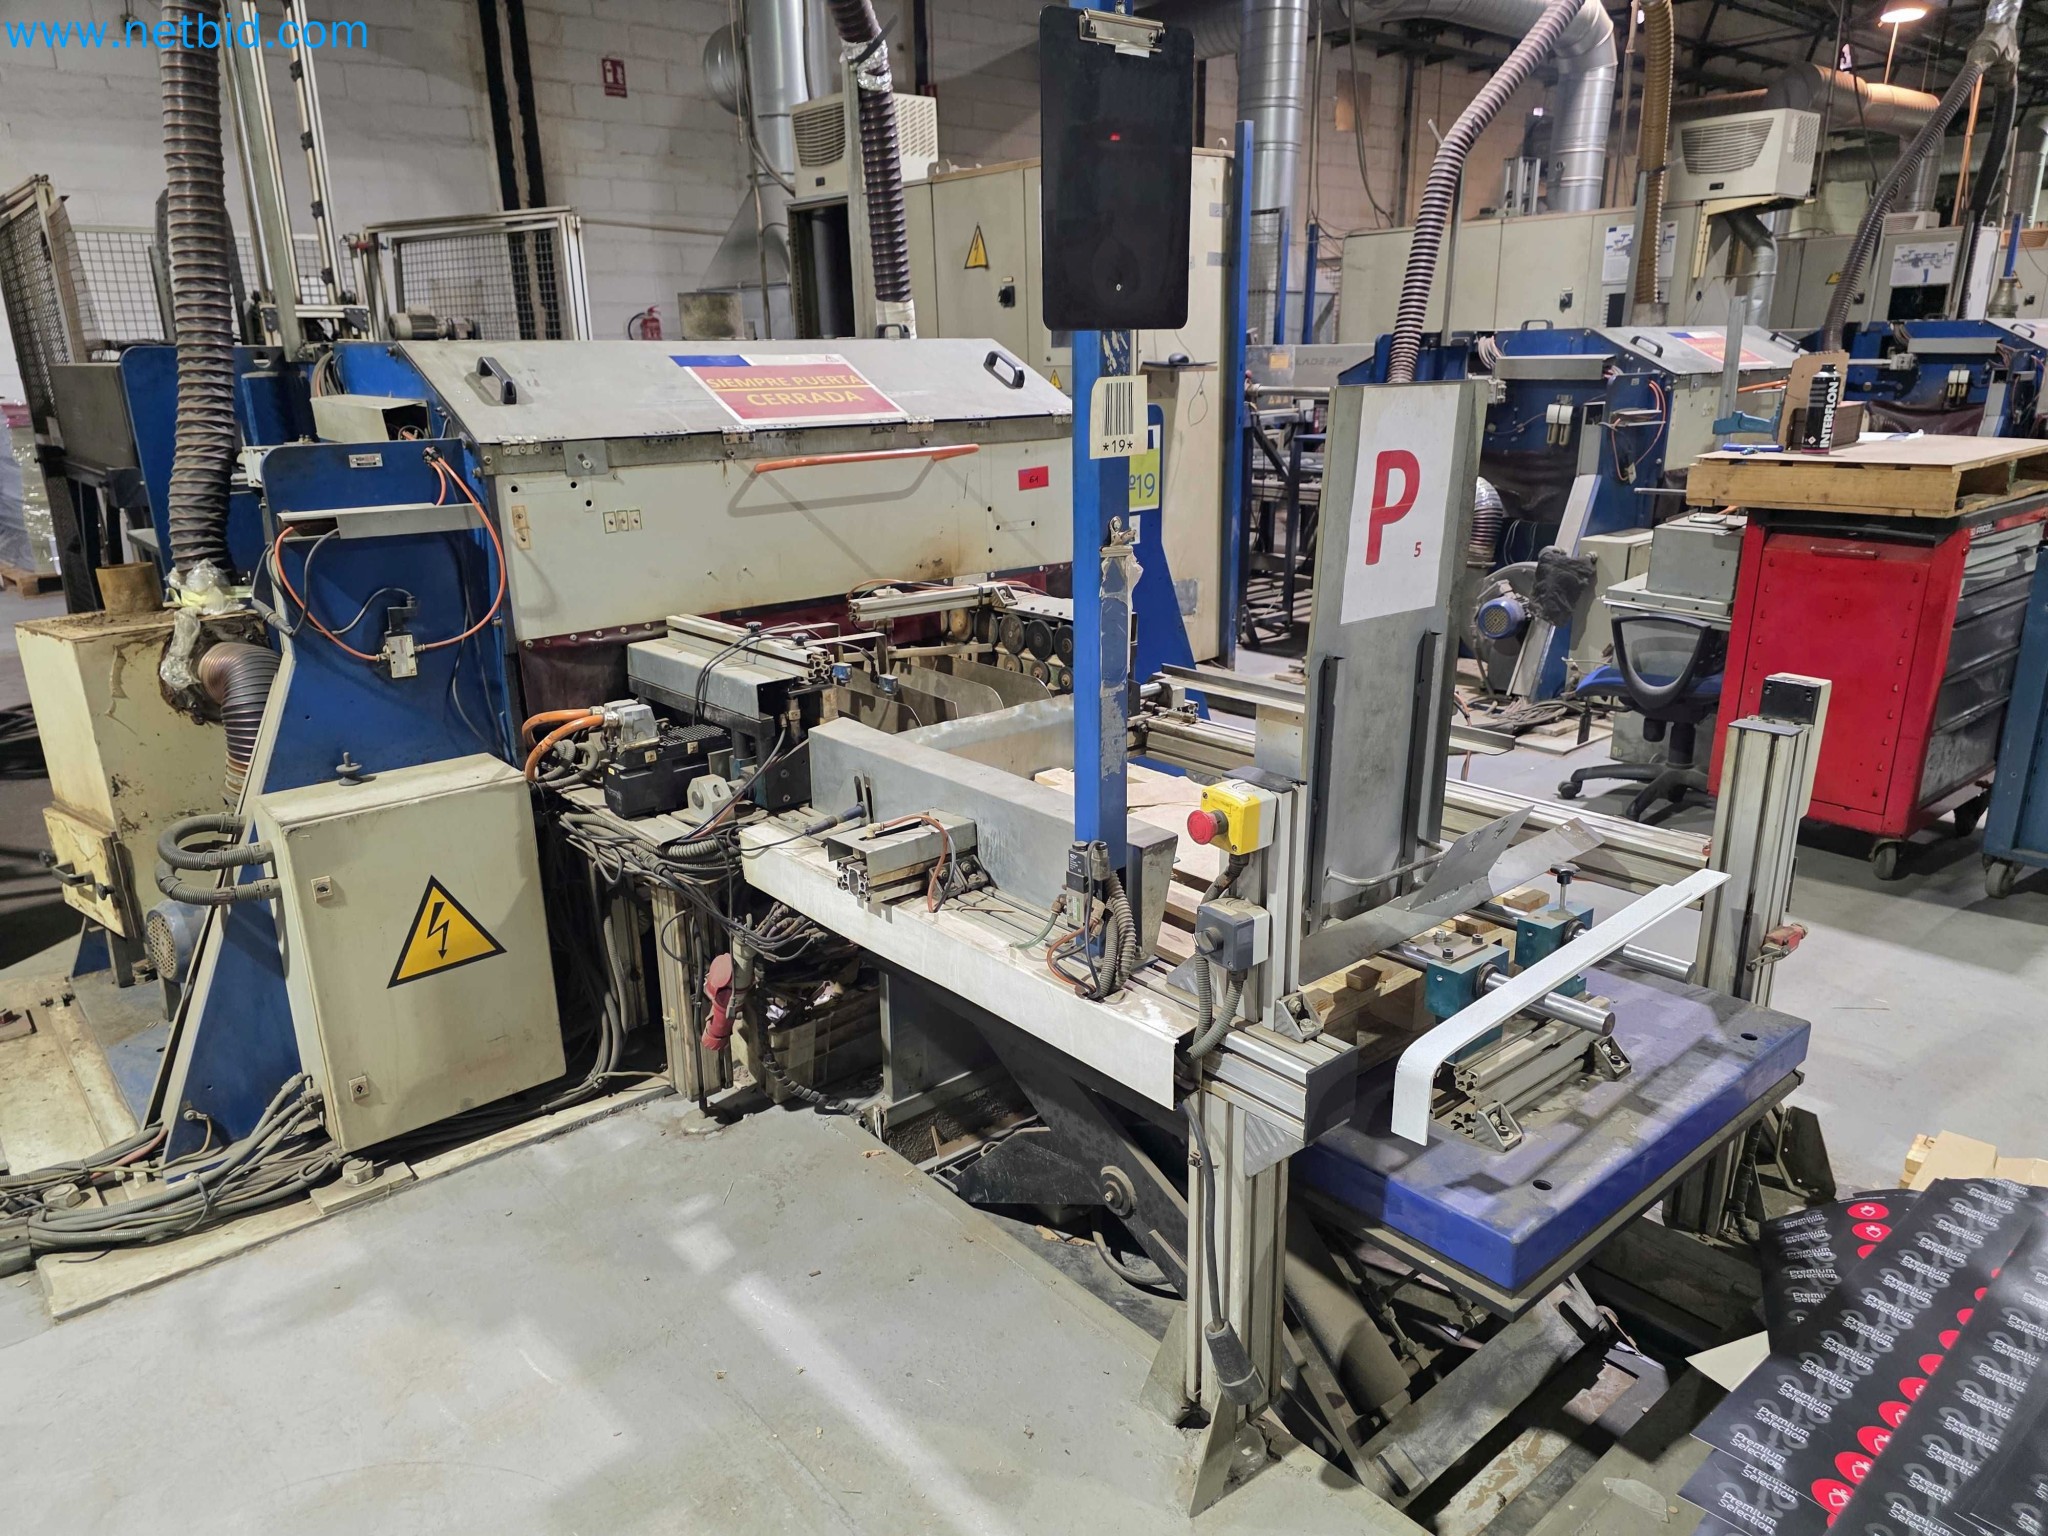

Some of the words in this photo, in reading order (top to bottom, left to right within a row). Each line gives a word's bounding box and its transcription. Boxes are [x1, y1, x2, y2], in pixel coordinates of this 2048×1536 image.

[706, 376, 790, 389] SIEMPRE
[791, 374, 864, 386] PUERTA
[747, 390, 864, 406] CERRADA
[1819, 381, 1839, 448] INTERFLON
[1365, 449, 1420, 566] P
[1413, 541, 1422, 557] 5
[1968, 1191, 2013, 1210] Selection
[1970, 1187, 2015, 1206] Premium
[1952, 1207, 1998, 1227] Selection
[1954, 1202, 2000, 1223] Premium
[1936, 1223, 1982, 1245] Selection
[1938, 1219, 1984, 1240] Premium
[1918, 1242, 1965, 1263] Selection
[1921, 1237, 1967, 1259] Premium
[1791, 1272, 1838, 1280] Selection
[1900, 1261, 1948, 1284] Selection
[1903, 1255, 1951, 1279] Premium
[1882, 1280, 1930, 1304] Selection
[1884, 1274, 1933, 1299] Premium
[1862, 1300, 1913, 1325] Selection
[1865, 1294, 1915, 1320] Premium
[1842, 1320, 1892, 1348] Selection
[1846, 1315, 1895, 1342] Premium
[1821, 1342, 1872, 1371] Selection
[1825, 1336, 1874, 1364] Premium
[1800, 1364, 1852, 1394] Selection
[1804, 1359, 1854, 1388] Premium
[1777, 1388, 1830, 1418] Selection
[1781, 1382, 1833, 1412] Premium
[1754, 1412, 1808, 1444] Selection
[1758, 1406, 1810, 1438] Premium
[1730, 1437, 1783, 1471] Selection
[1734, 1431, 1787, 1464] Premium
[1741, 1469, 1796, 1503] Selection
[1718, 1497, 1775, 1535] Selection
[1722, 1491, 1778, 1527] Premium
